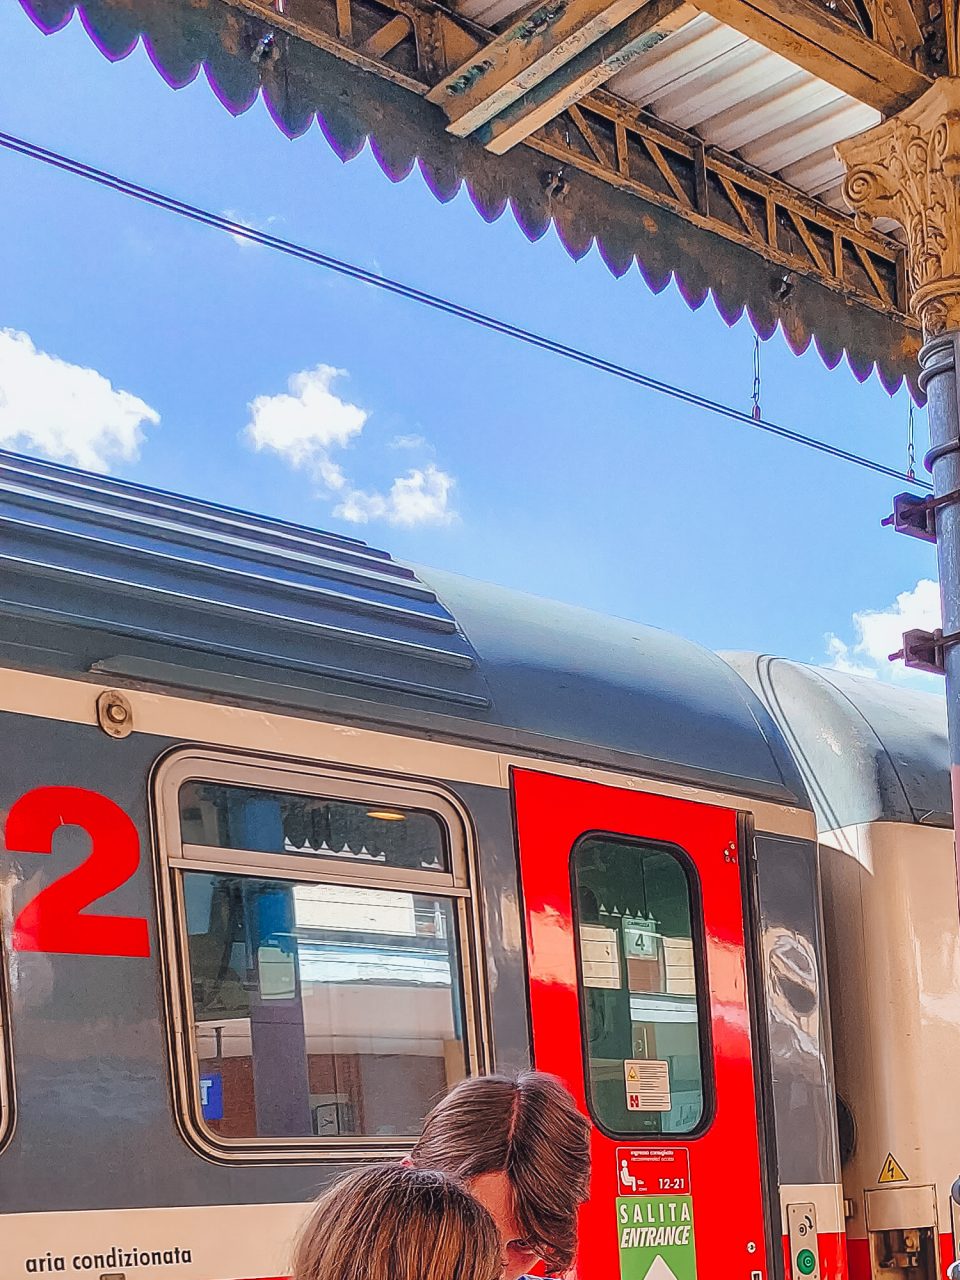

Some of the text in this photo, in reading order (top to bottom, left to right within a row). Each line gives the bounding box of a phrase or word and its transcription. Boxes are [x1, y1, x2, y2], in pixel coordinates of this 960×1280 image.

[5, 786, 150, 958] 2
[635, 933, 645, 951] 4
[658, 1178, 685, 1190] 12-21
[620, 1203, 691, 1224] SALITA
[620, 1225, 691, 1249] ENTRANCE
[26, 1247, 192, 1273] aria condizionata
